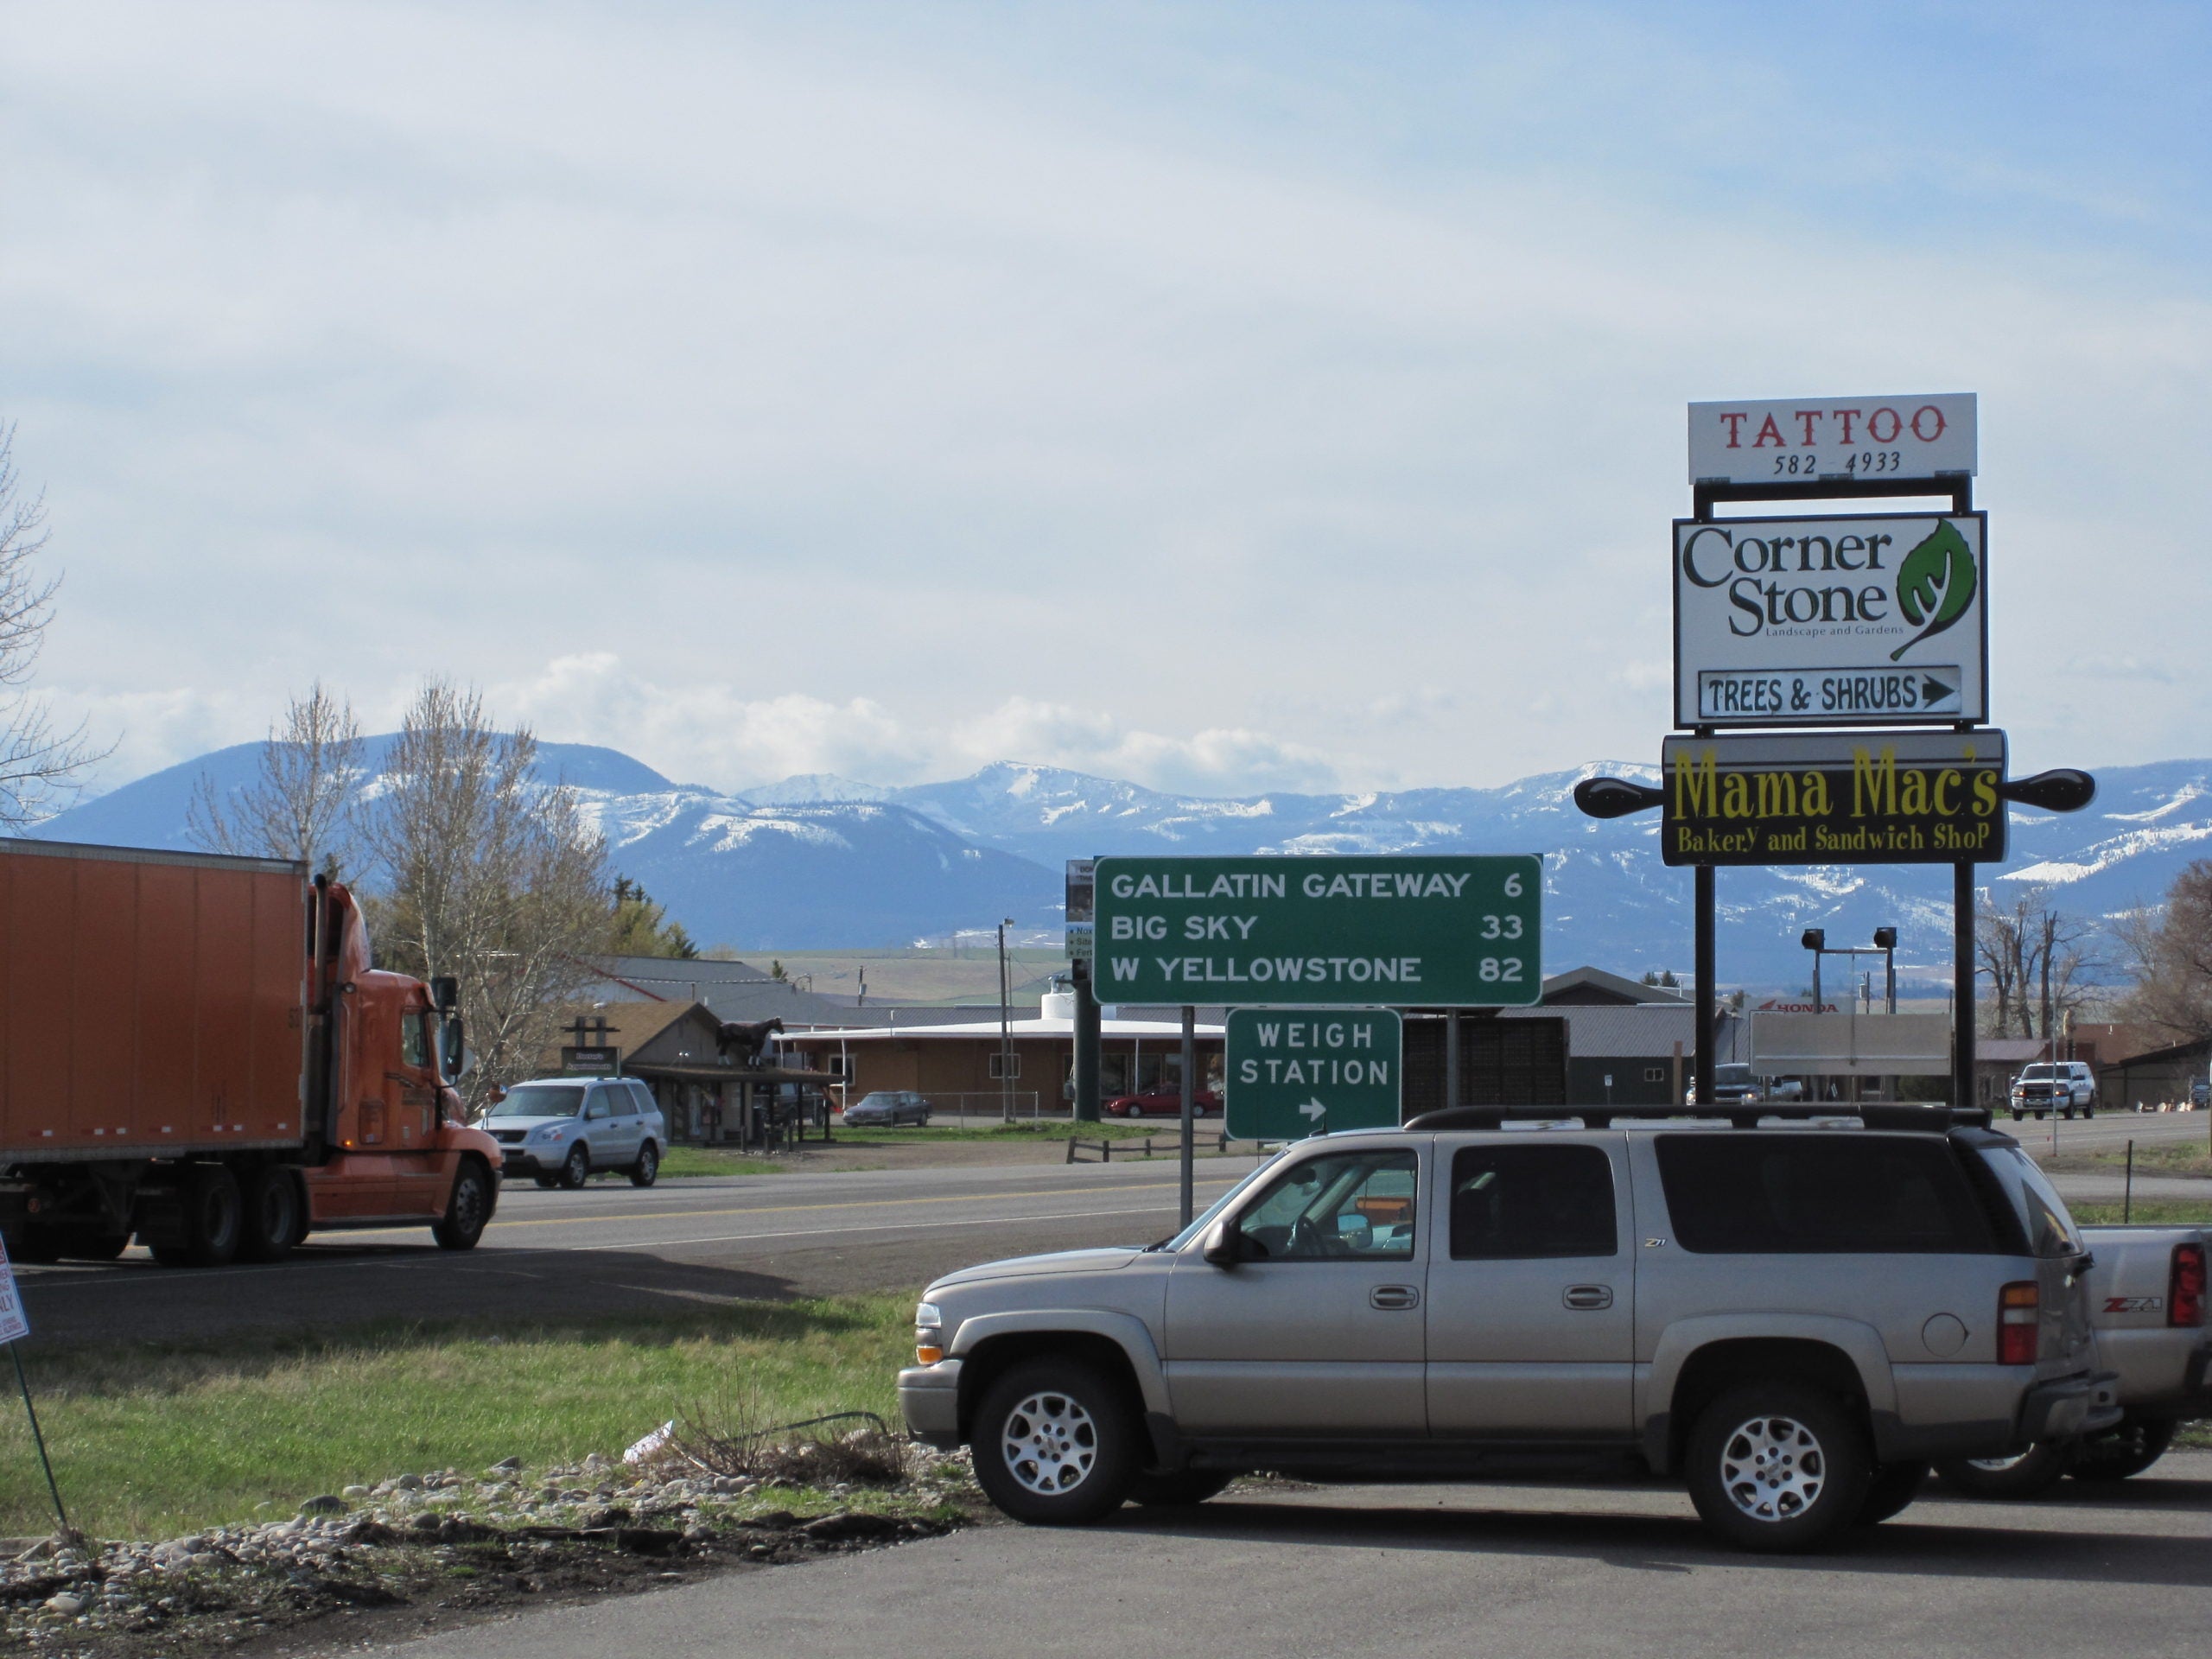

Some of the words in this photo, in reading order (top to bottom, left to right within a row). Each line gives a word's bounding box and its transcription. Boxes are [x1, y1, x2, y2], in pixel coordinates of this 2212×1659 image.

[1720, 405, 1948, 448] TATTOO
[1774, 455, 1816, 474] 582
[1846, 452, 1901, 474] 4933
[1682, 527, 1892, 588] Corner
[1728, 577, 1888, 637] Stone
[1766, 626, 1826, 638] Landscape
[1830, 626, 1851, 635] and
[1855, 625, 1904, 635] Gardens
[1709, 678, 1783, 712] TREES
[1790, 678, 1811, 711] &
[1821, 675, 1916, 711] SHRUBS
[1671, 746, 1834, 820] Mama
[1849, 743, 1998, 818] Mac's
[1678, 826, 1759, 853] Bakery
[1768, 827, 1807, 851] and
[1815, 823, 1924, 851] Sandwich
[1111, 874, 1285, 898] GALLATIN
[1303, 873, 1471, 898] GATEWAY
[1504, 873, 1523, 898] 6
[1111, 916, 1167, 940] BIG
[1184, 916, 1258, 940] SKY
[1480, 916, 1523, 940] 33
[1111, 957, 1140, 982] W
[1155, 957, 1422, 982] YELLOWSTONE
[1479, 957, 1523, 982] 82
[1257, 1023, 1372, 1048] WEIGH
[1240, 1059, 1388, 1084] STATION
[1644, 1237, 1667, 1248] Z71
[2101, 1296, 2163, 1313] Z71
